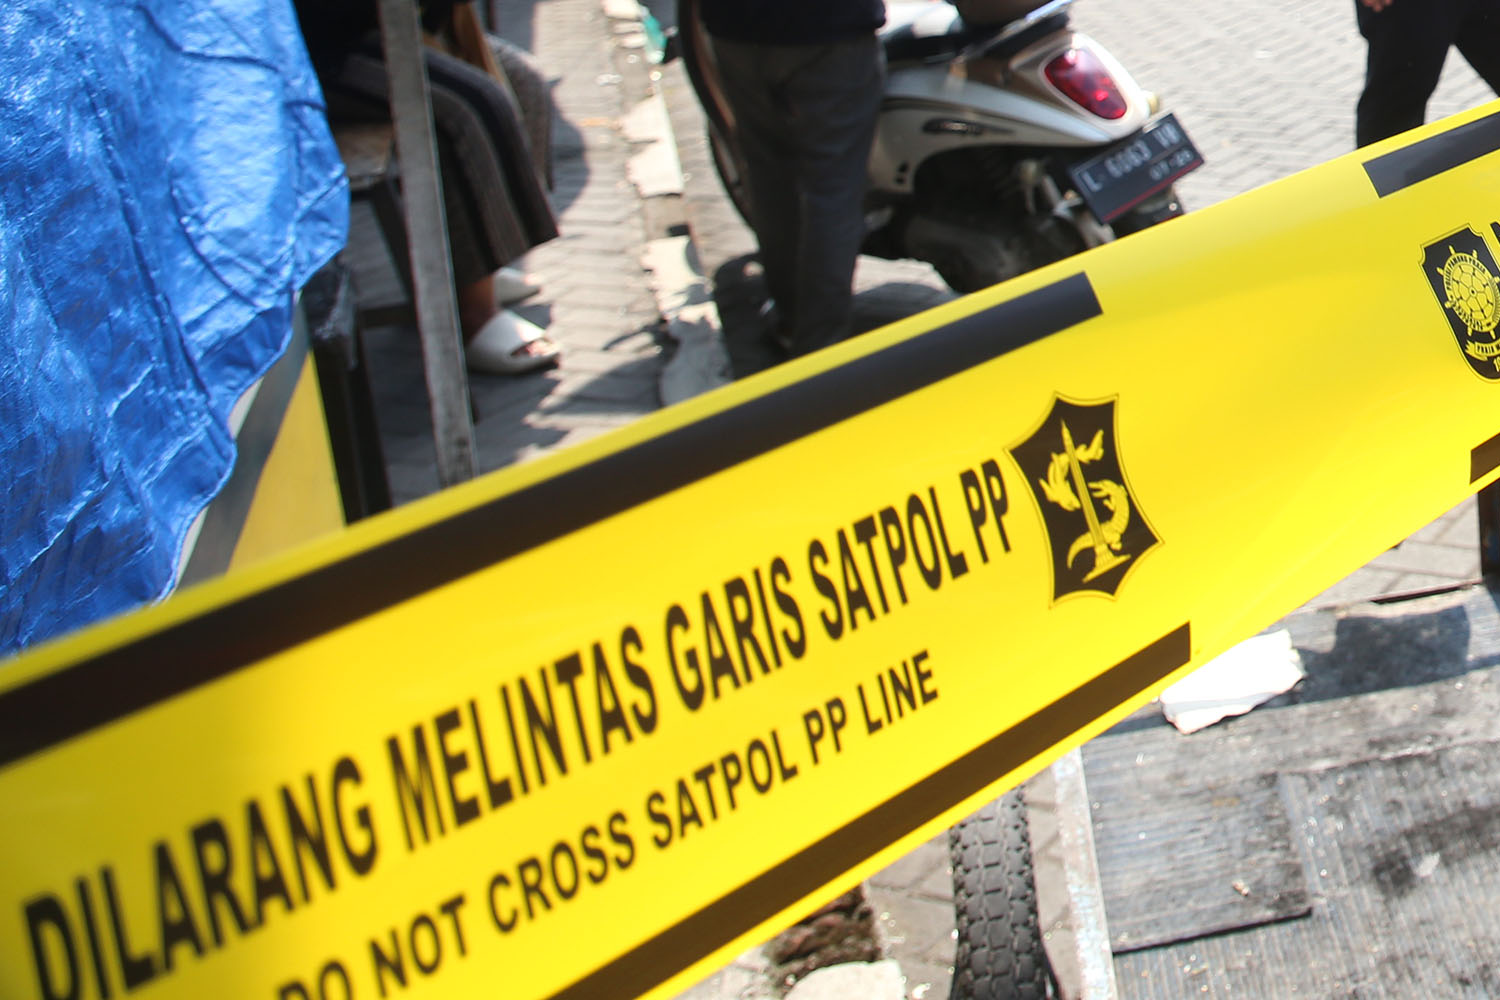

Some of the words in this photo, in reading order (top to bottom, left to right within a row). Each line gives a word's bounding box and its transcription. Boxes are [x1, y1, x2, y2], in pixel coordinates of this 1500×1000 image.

[24, 755, 378, 1000] DILARANG
[385, 625, 660, 852] MELINTAS
[665, 556, 806, 710] GARIS
[808, 487, 970, 641] SATPOL
[959, 458, 1011, 565] PP
[368, 895, 467, 997] NOT
[487, 810, 636, 935] CROSS
[646, 730, 798, 849] SATPOL
[803, 697, 847, 765] PP
[857, 649, 938, 735] LINE
